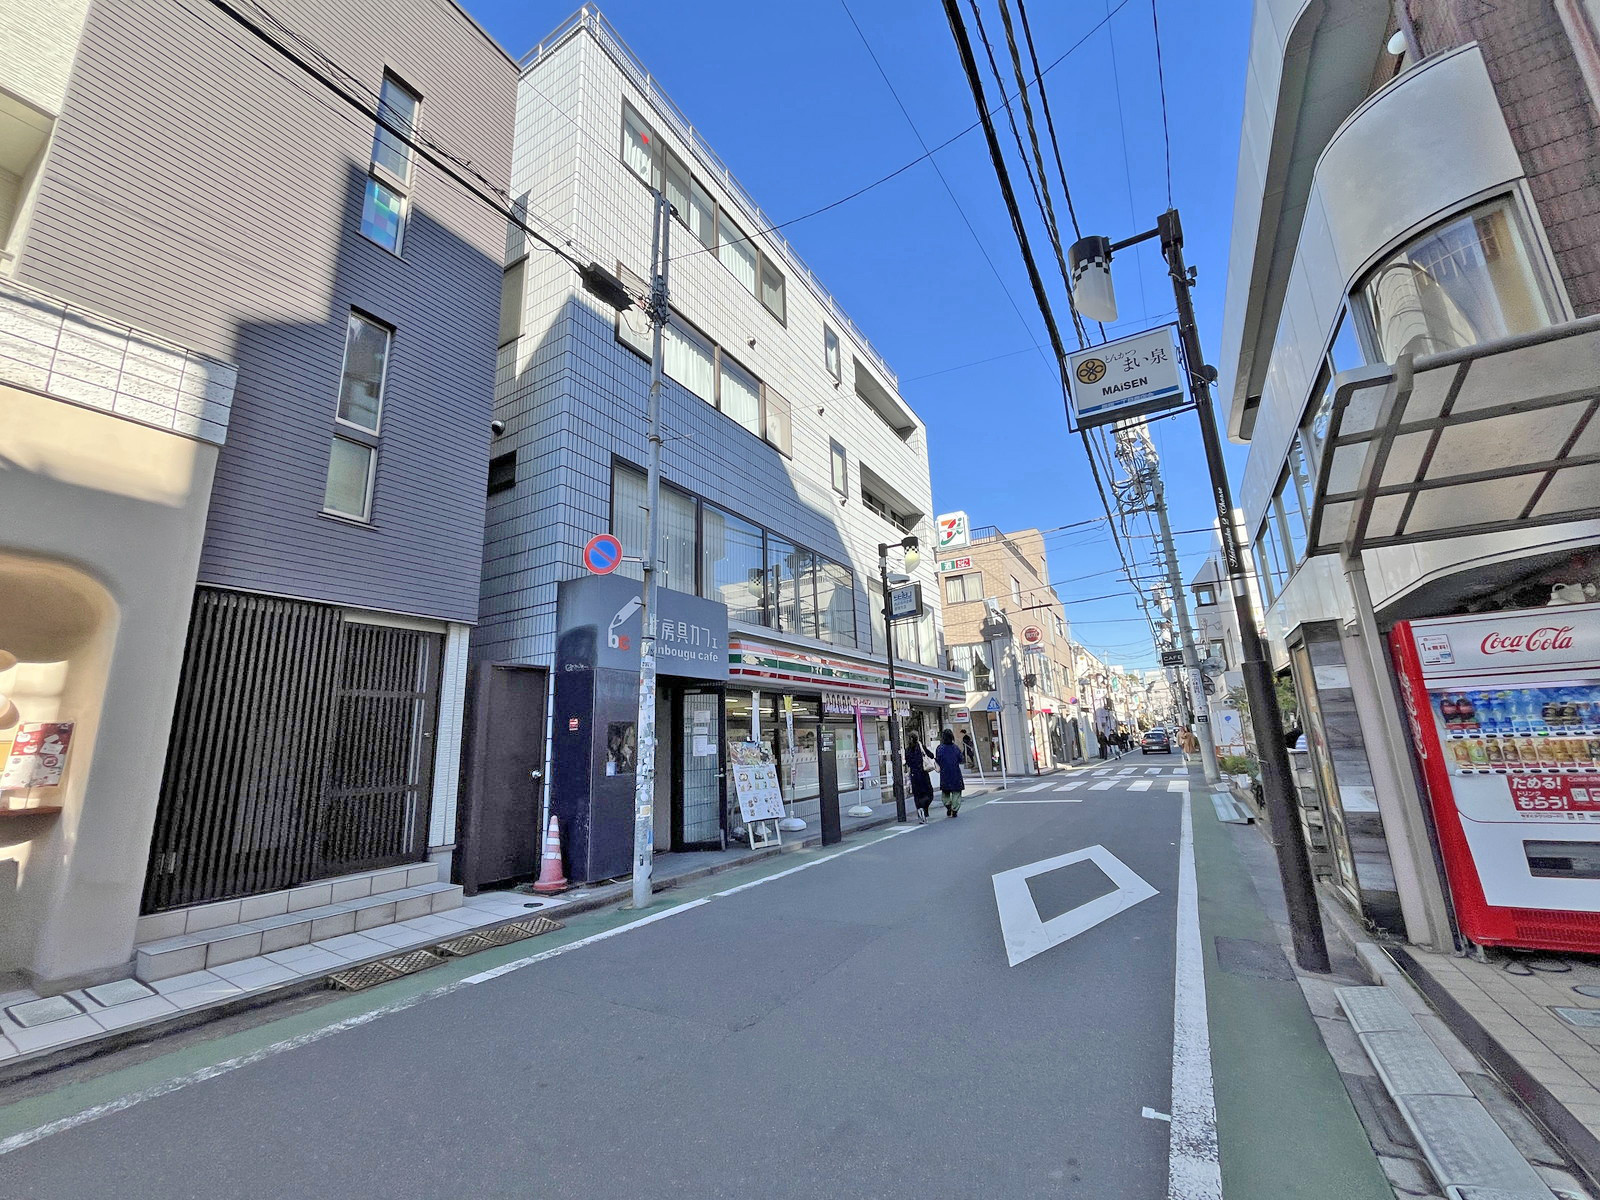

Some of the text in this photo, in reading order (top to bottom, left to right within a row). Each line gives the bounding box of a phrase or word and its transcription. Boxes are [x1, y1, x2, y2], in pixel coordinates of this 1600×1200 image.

[1123, 348, 1168, 372] まい泉
[655, 618, 718, 649] 房具カフェ
[1480, 625, 1576, 655] Coca-Cola
[698, 651, 719, 662] cafe
[1163, 654, 1183, 662] CAFE
[1512, 777, 1562, 790] ためる!
[1518, 796, 1569, 810] もらう!
